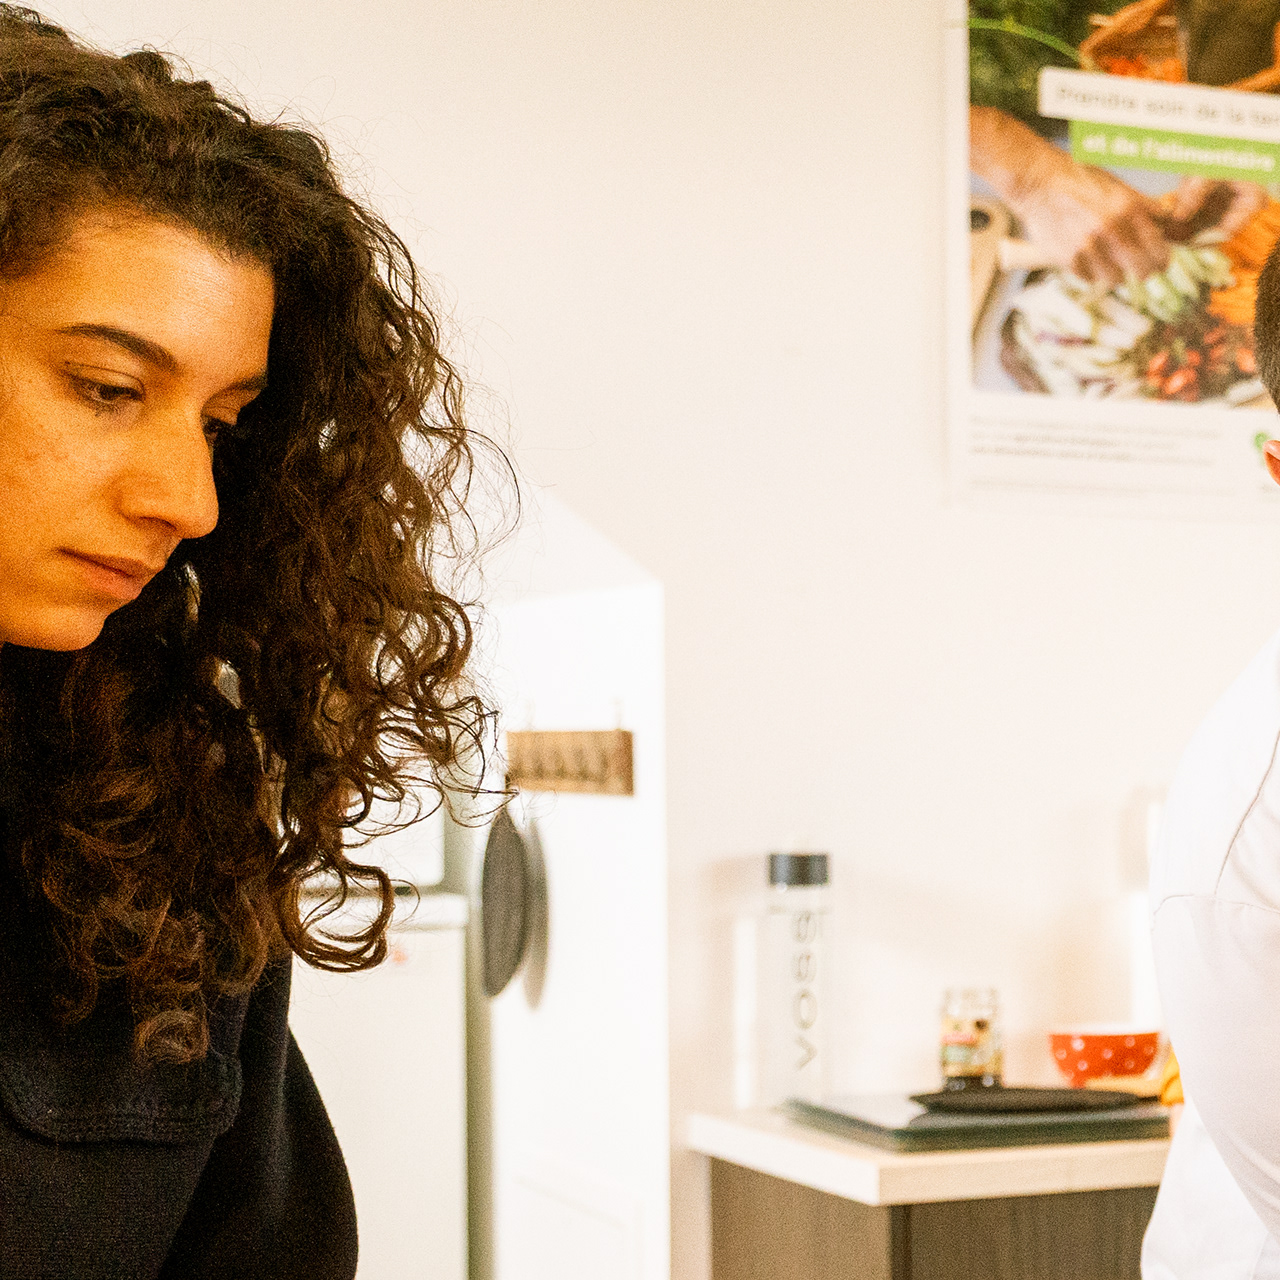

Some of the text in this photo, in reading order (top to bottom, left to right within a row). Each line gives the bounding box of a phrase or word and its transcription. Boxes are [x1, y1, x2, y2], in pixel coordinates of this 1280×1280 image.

[1056, 84, 1138, 111] Prendre
[1146, 97, 1185, 116] soin
[1196, 100, 1219, 120] de
[1229, 104, 1245, 124] la
[1083, 134, 1107, 153] et
[1113, 136, 1138, 157] de
[793, 911, 817, 1070] VOSS
